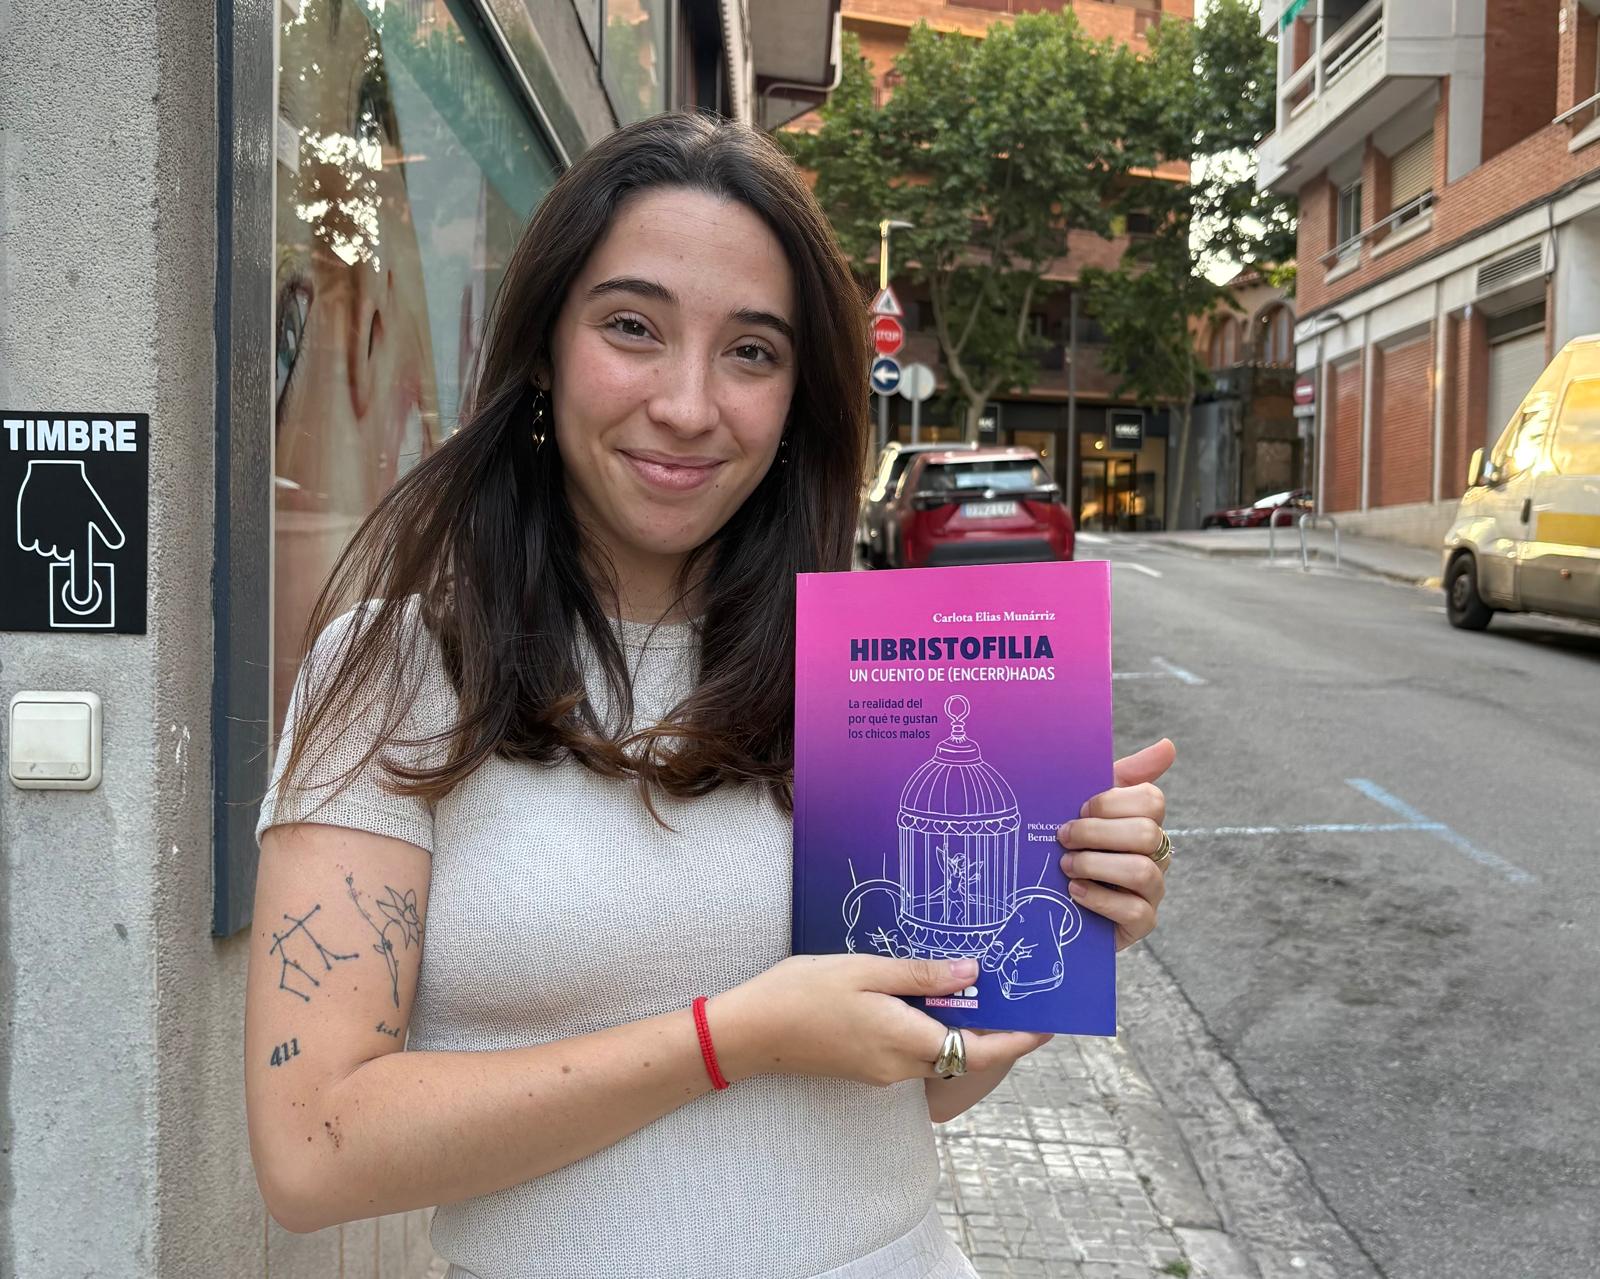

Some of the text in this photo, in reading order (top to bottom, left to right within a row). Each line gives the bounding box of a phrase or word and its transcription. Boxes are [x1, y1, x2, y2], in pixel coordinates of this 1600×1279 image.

[3, 419, 137, 451] TIMBRE
[932, 610, 1056, 623] Carlota Elias Munárriz
[850, 635, 1054, 661] HIBRISTOFILIA
[849, 666, 1055, 682] UN CUENTO DE (ENCERR)HADAS
[848, 698, 923, 709] La realidad del
[848, 713, 938, 726] por qué te gustan
[848, 728, 931, 739] los chicos malos
[1027, 832, 1057, 842] Bernat
[269, 1037, 301, 1067] 411
